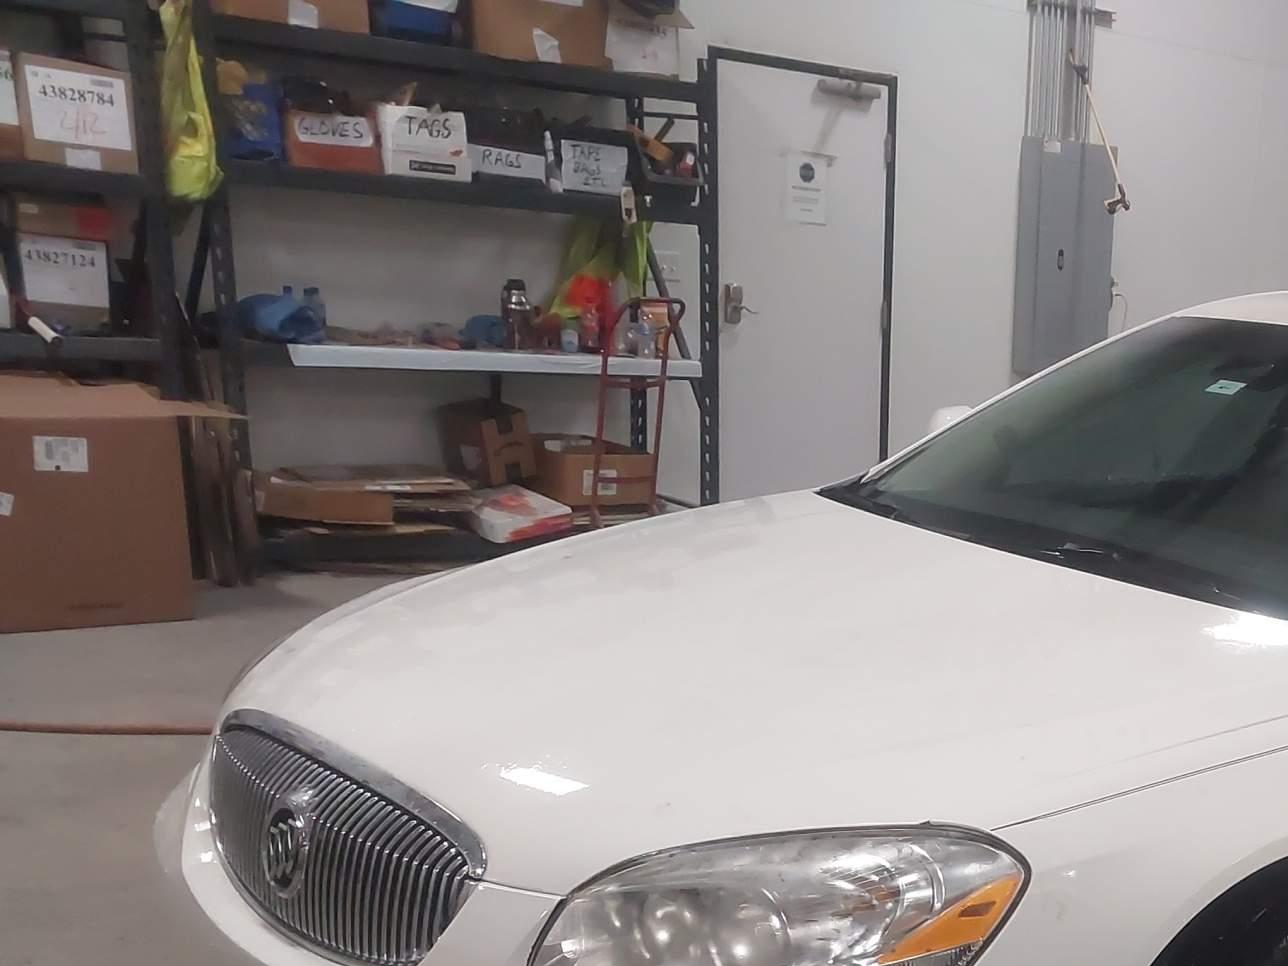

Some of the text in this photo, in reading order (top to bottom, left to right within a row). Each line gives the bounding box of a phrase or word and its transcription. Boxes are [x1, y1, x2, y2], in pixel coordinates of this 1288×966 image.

[38, 84, 115, 107] 43828784
[300, 117, 364, 139] GLOVES
[405, 115, 452, 139] TAGS
[481, 148, 522, 169] RAGS
[25, 249, 96, 268] 43827124
